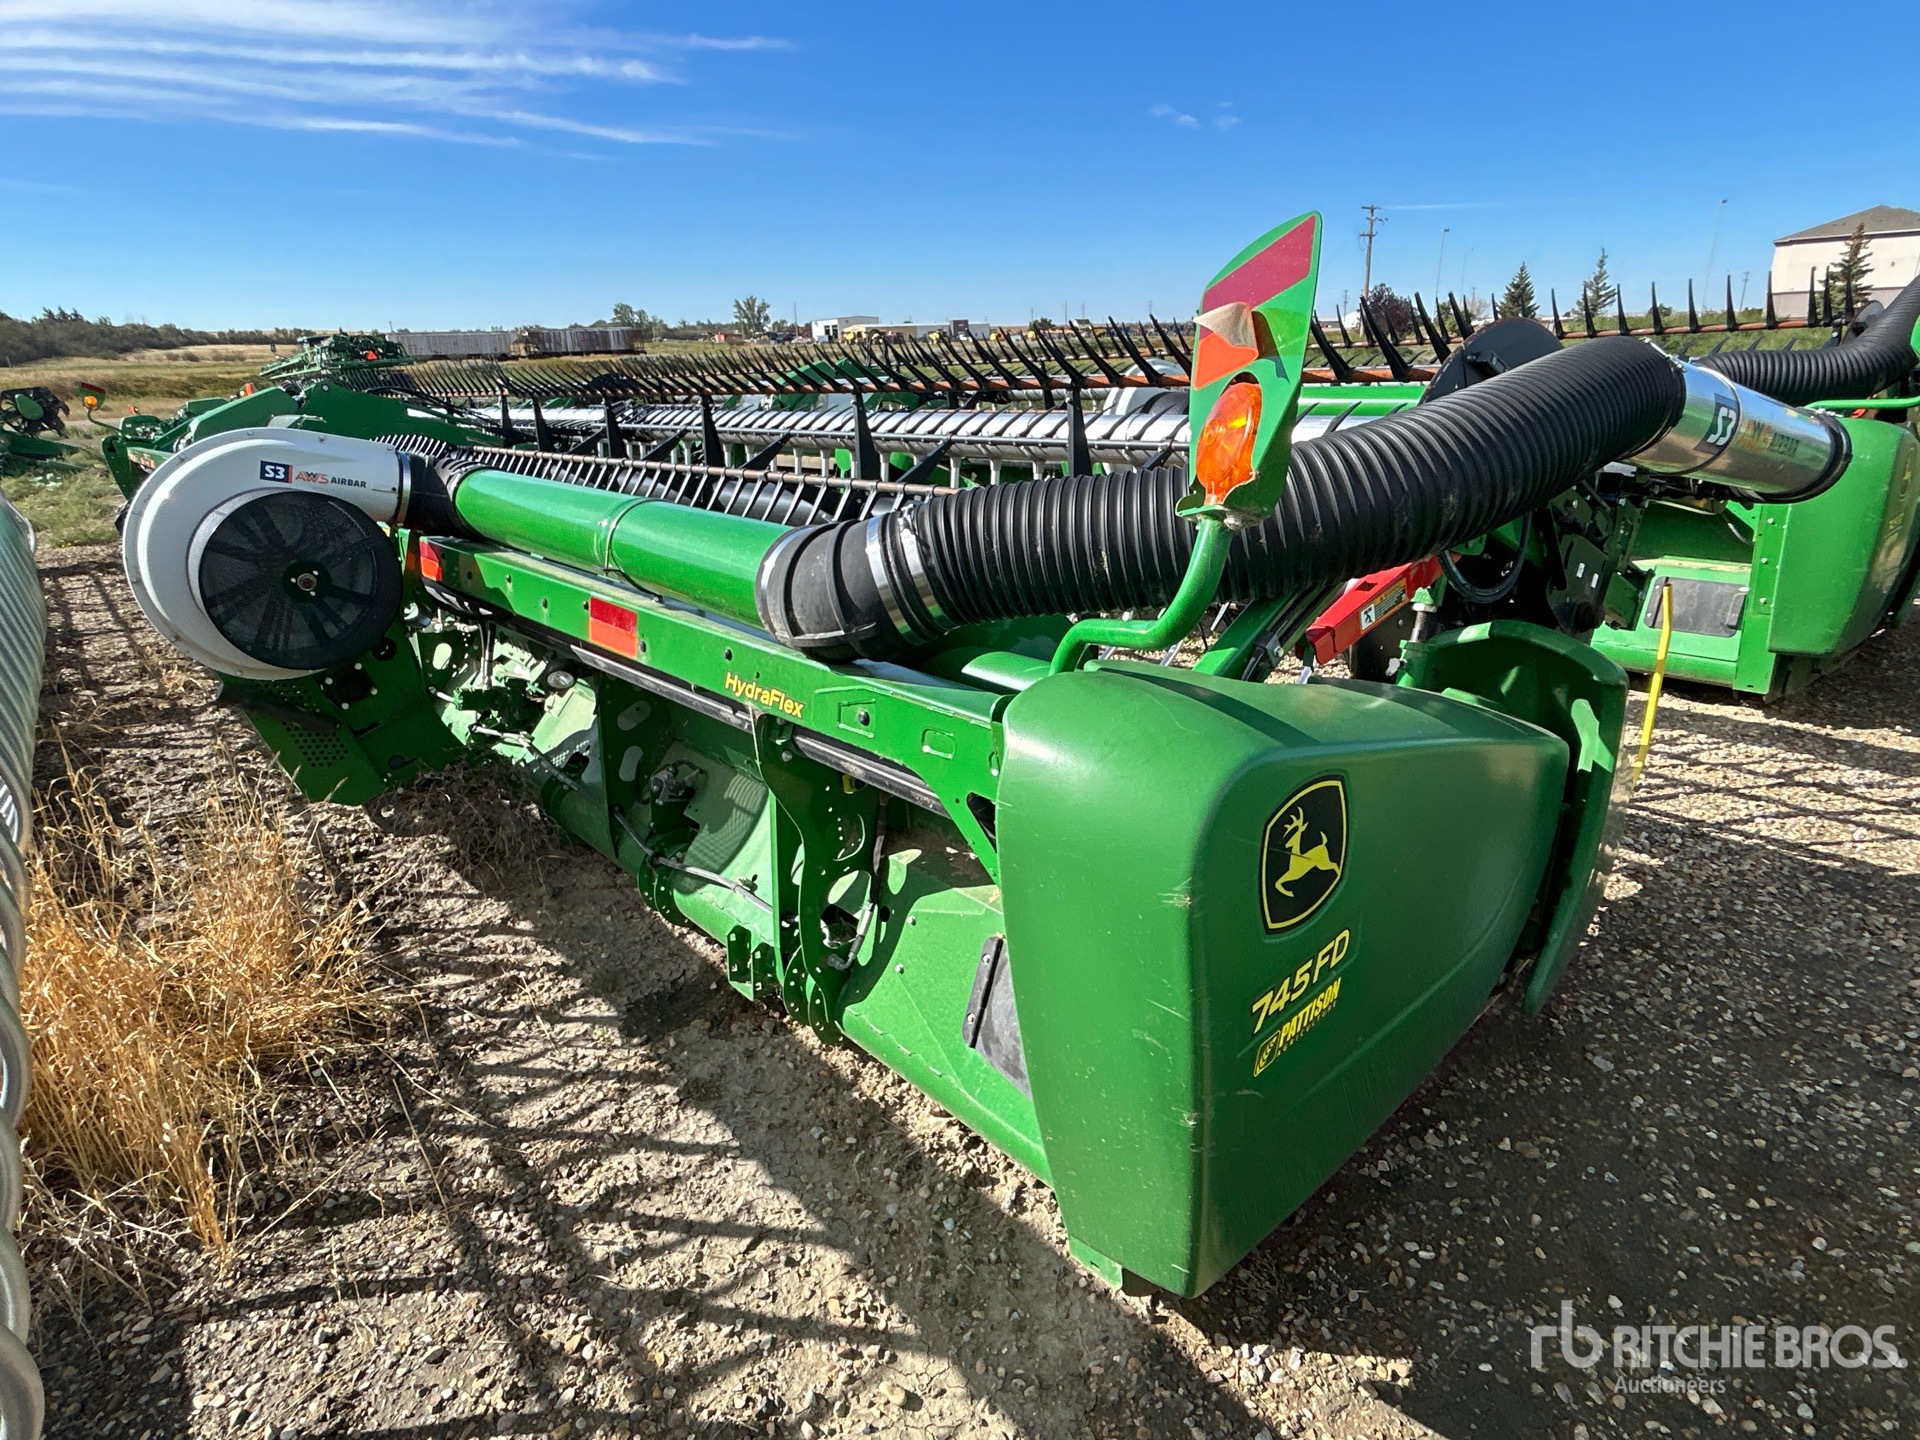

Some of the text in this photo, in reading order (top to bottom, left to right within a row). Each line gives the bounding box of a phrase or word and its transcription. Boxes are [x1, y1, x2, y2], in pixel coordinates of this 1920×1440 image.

[1706, 406, 1737, 446] S3
[264, 464, 367, 489] S3 AWS AIRBAR
[724, 671, 805, 719] HydraFlex
[1251, 928, 1351, 1035] 745FD
[1278, 976, 1342, 1049] PATTISON
